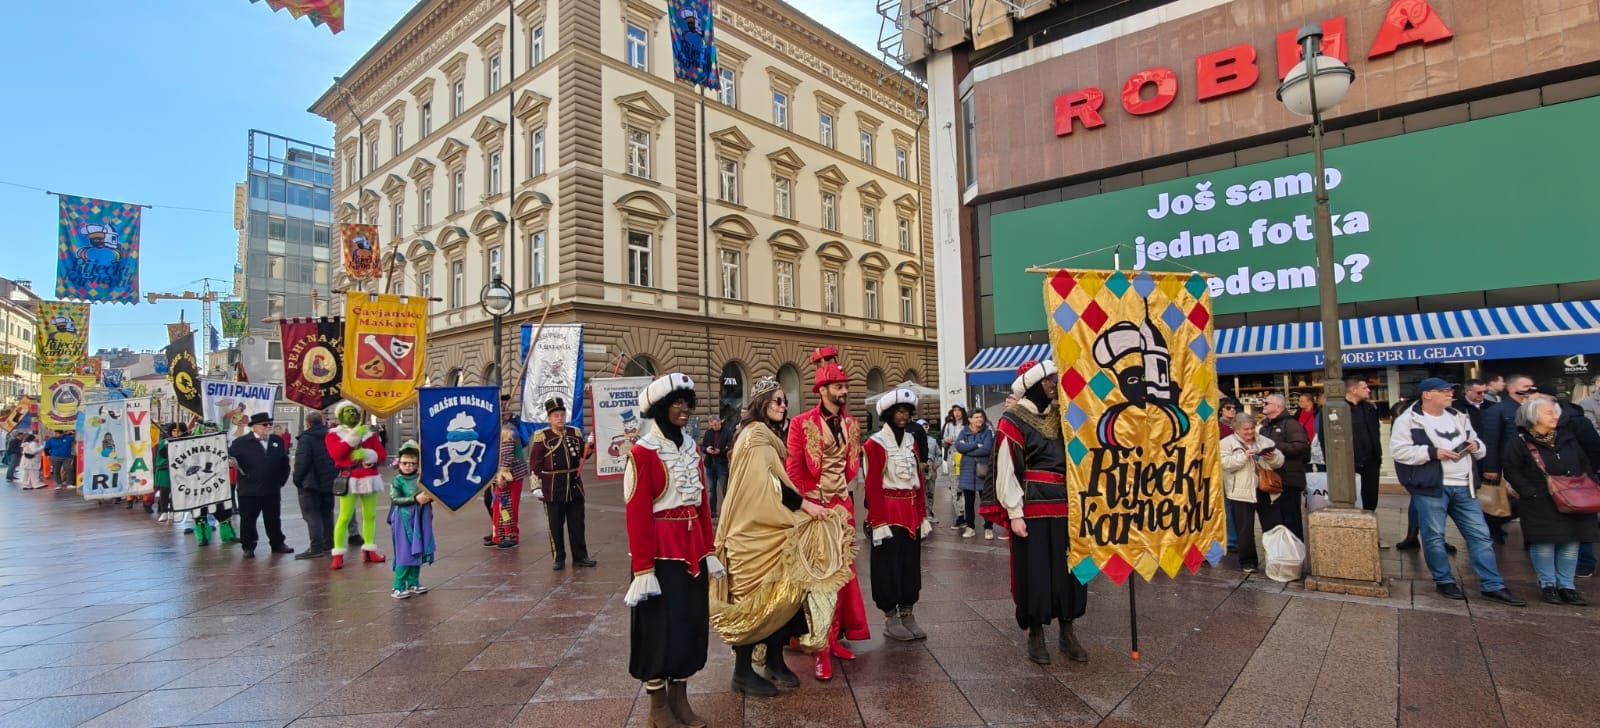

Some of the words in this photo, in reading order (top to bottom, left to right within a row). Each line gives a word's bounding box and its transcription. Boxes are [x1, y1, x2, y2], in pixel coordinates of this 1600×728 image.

[1147, 180, 1216, 219] Još
[1225, 167, 1342, 206] samo
[1133, 230, 1240, 270] jedna
[1206, 253, 1370, 298] edem?
[352, 306, 423, 319] Čavjanske
[359, 318, 417, 329] Maškare
[1314, 351, 1375, 366] L'MORE
[1376, 350, 1404, 362] PER
[1407, 348, 1422, 360] IL
[1423, 344, 1486, 359] GELATO
[207, 382, 229, 396] SITI
[230, 384, 235, 397] I
[234, 384, 271, 400] PIJANI
[609, 390, 639, 400] VESELI
[428, 396, 458, 418] DRAŠKE
[460, 394, 494, 413] MAŠKARE
[599, 399, 640, 408] OLDTIME
[92, 472, 119, 490] RI
[1078, 477, 1215, 546] karneval
